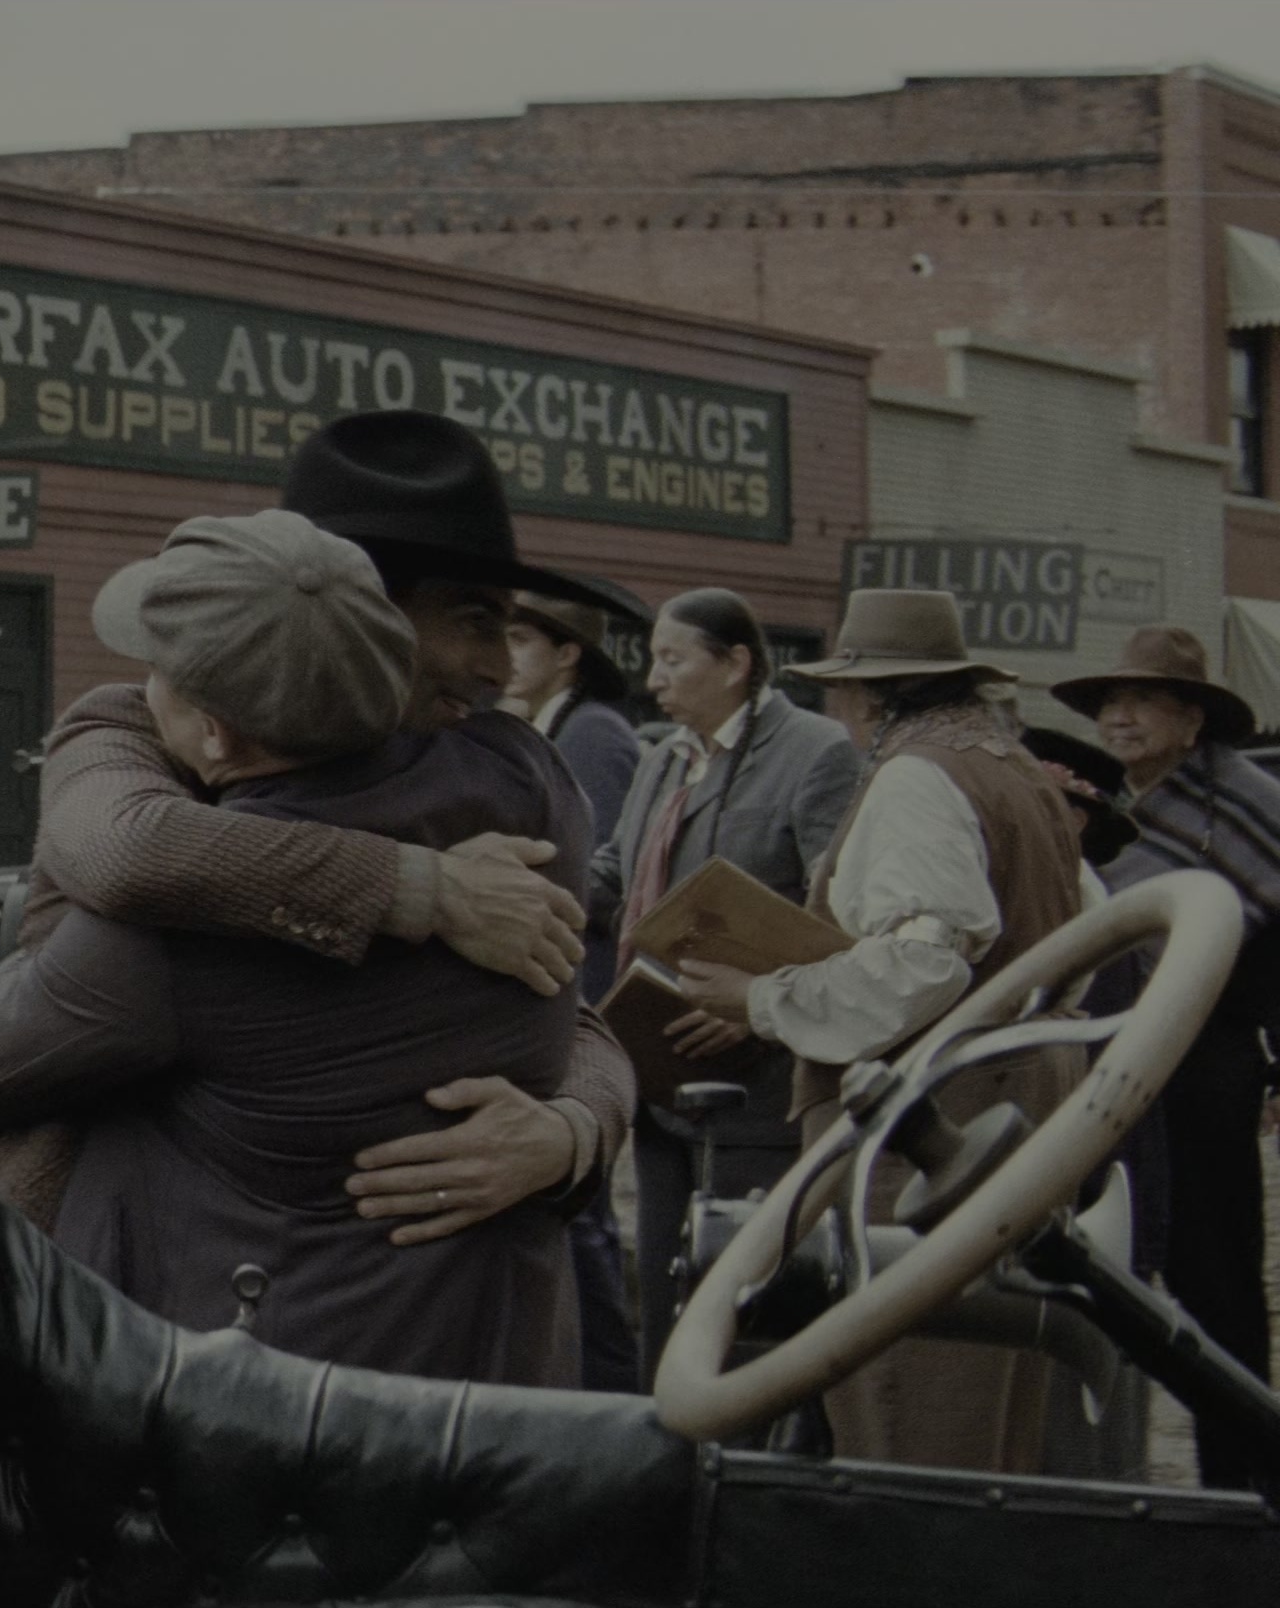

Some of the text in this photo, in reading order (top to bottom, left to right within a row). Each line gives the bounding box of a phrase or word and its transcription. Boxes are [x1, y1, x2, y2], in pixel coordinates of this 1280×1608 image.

[216, 324, 416, 412] AUTO
[440, 358, 769, 467] EXCHANGE
[480, 437, 546, 492] PS
[562, 449, 592, 496] &
[606, 456, 770, 519] ENGINES
[853, 545, 1073, 596] FILLING
[957, 599, 1070, 645] TION
